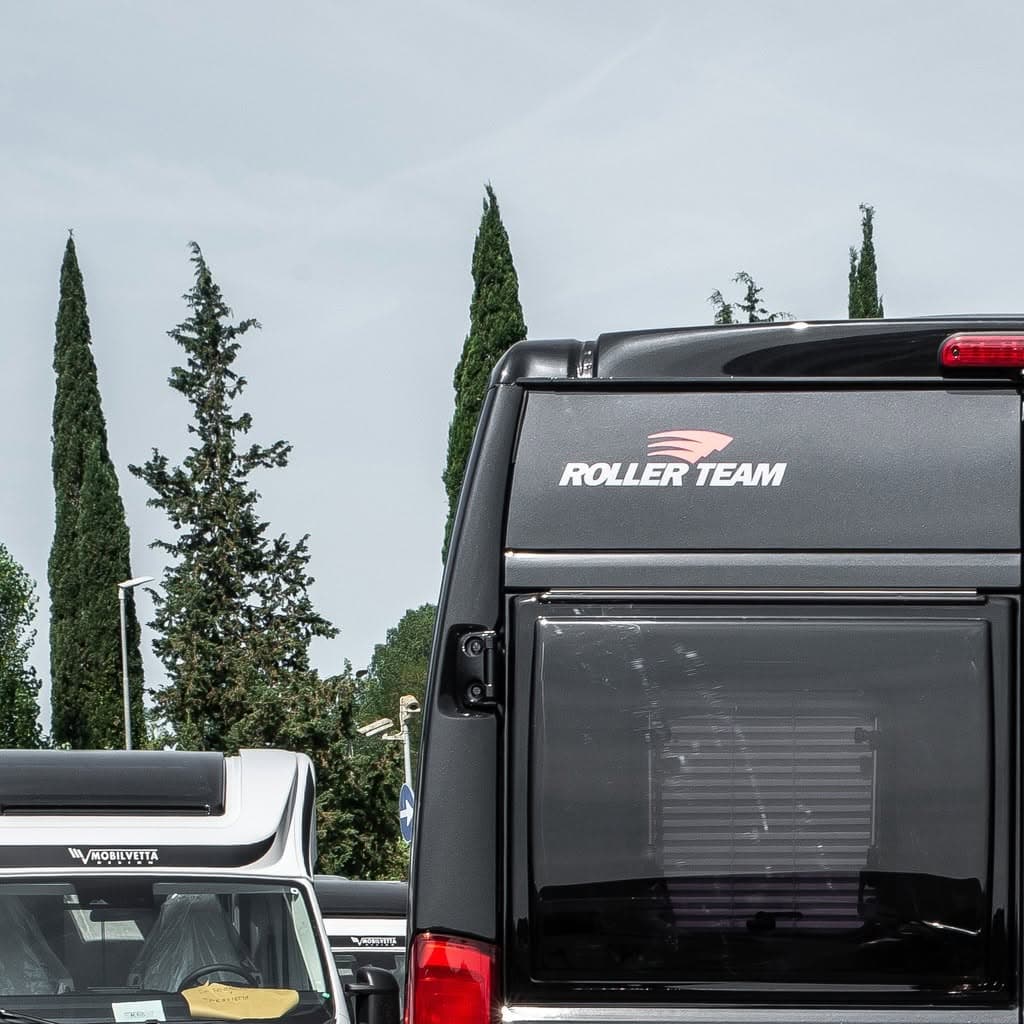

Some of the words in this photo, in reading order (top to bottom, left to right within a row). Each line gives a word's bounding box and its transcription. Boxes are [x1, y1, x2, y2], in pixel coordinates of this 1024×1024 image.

[558, 462, 690, 487] ROLLER
[695, 462, 788, 487] TEAM
[90, 851, 159, 861] MOBILVETTA
